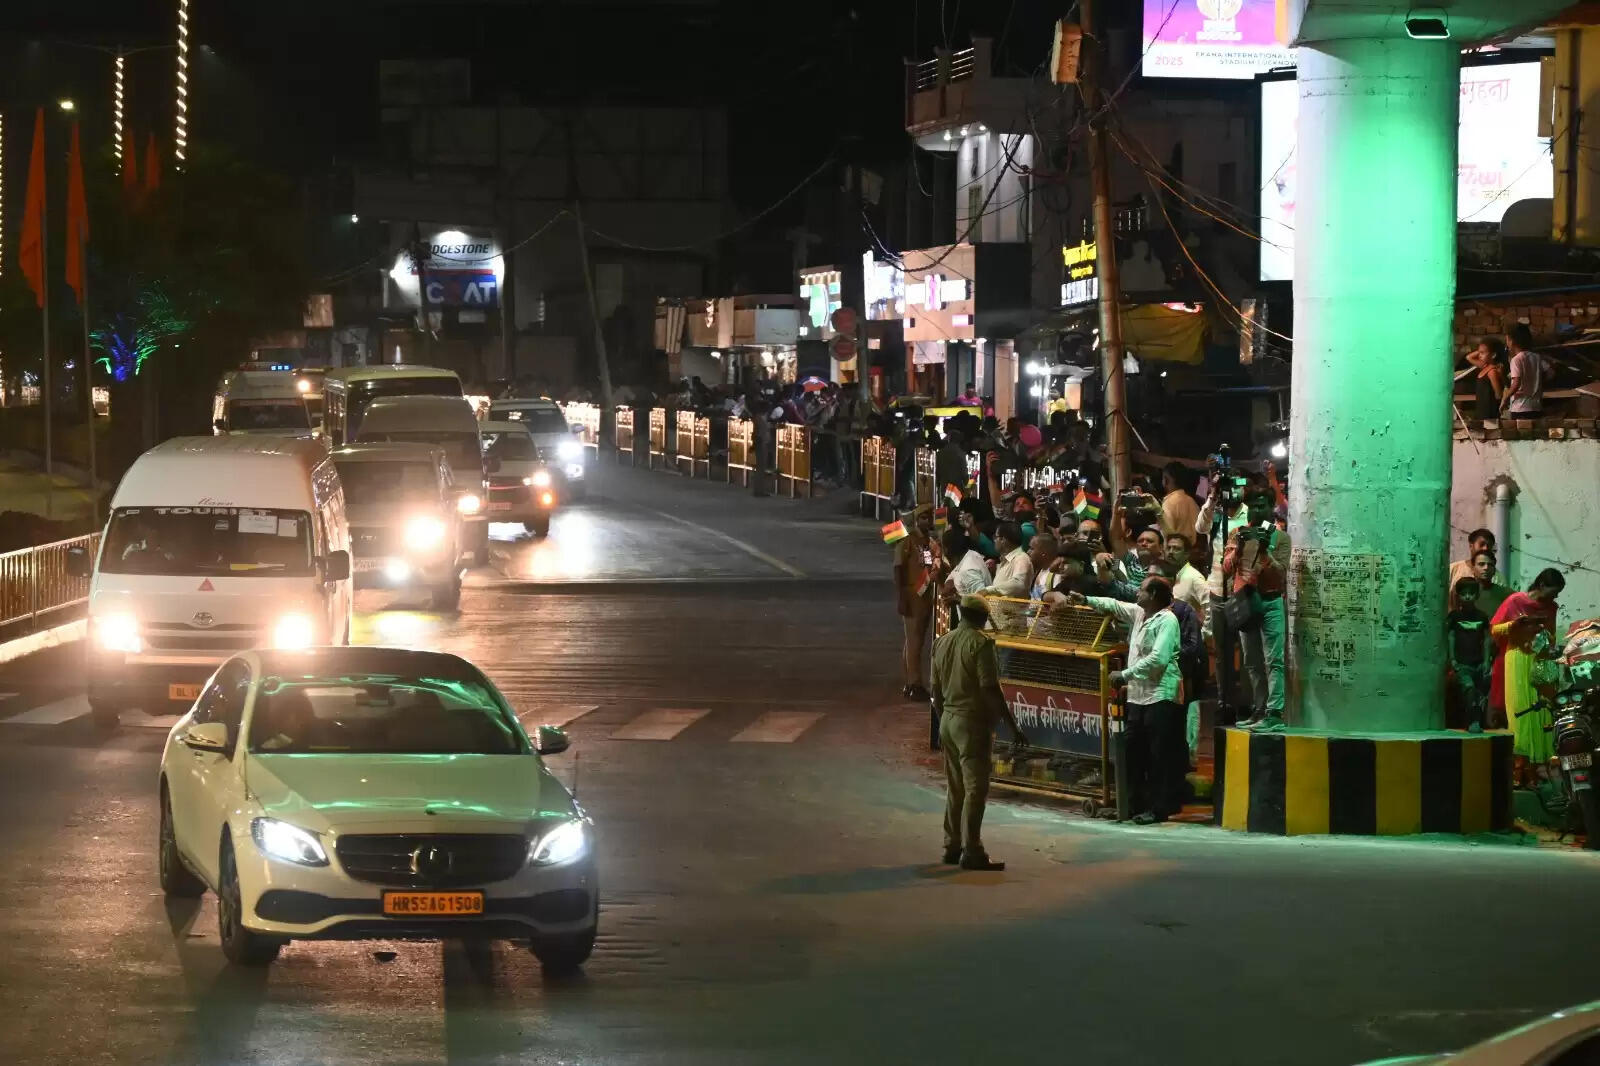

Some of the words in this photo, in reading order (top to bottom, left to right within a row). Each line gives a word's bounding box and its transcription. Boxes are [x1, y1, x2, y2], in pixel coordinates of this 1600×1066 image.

[1225, 51, 1286, 59] INTERNATIONAL
[1155, 56, 1184, 66] 2025
[431, 243, 490, 255] DGESTONE
[1012, 691, 1038, 728] पुलिस
